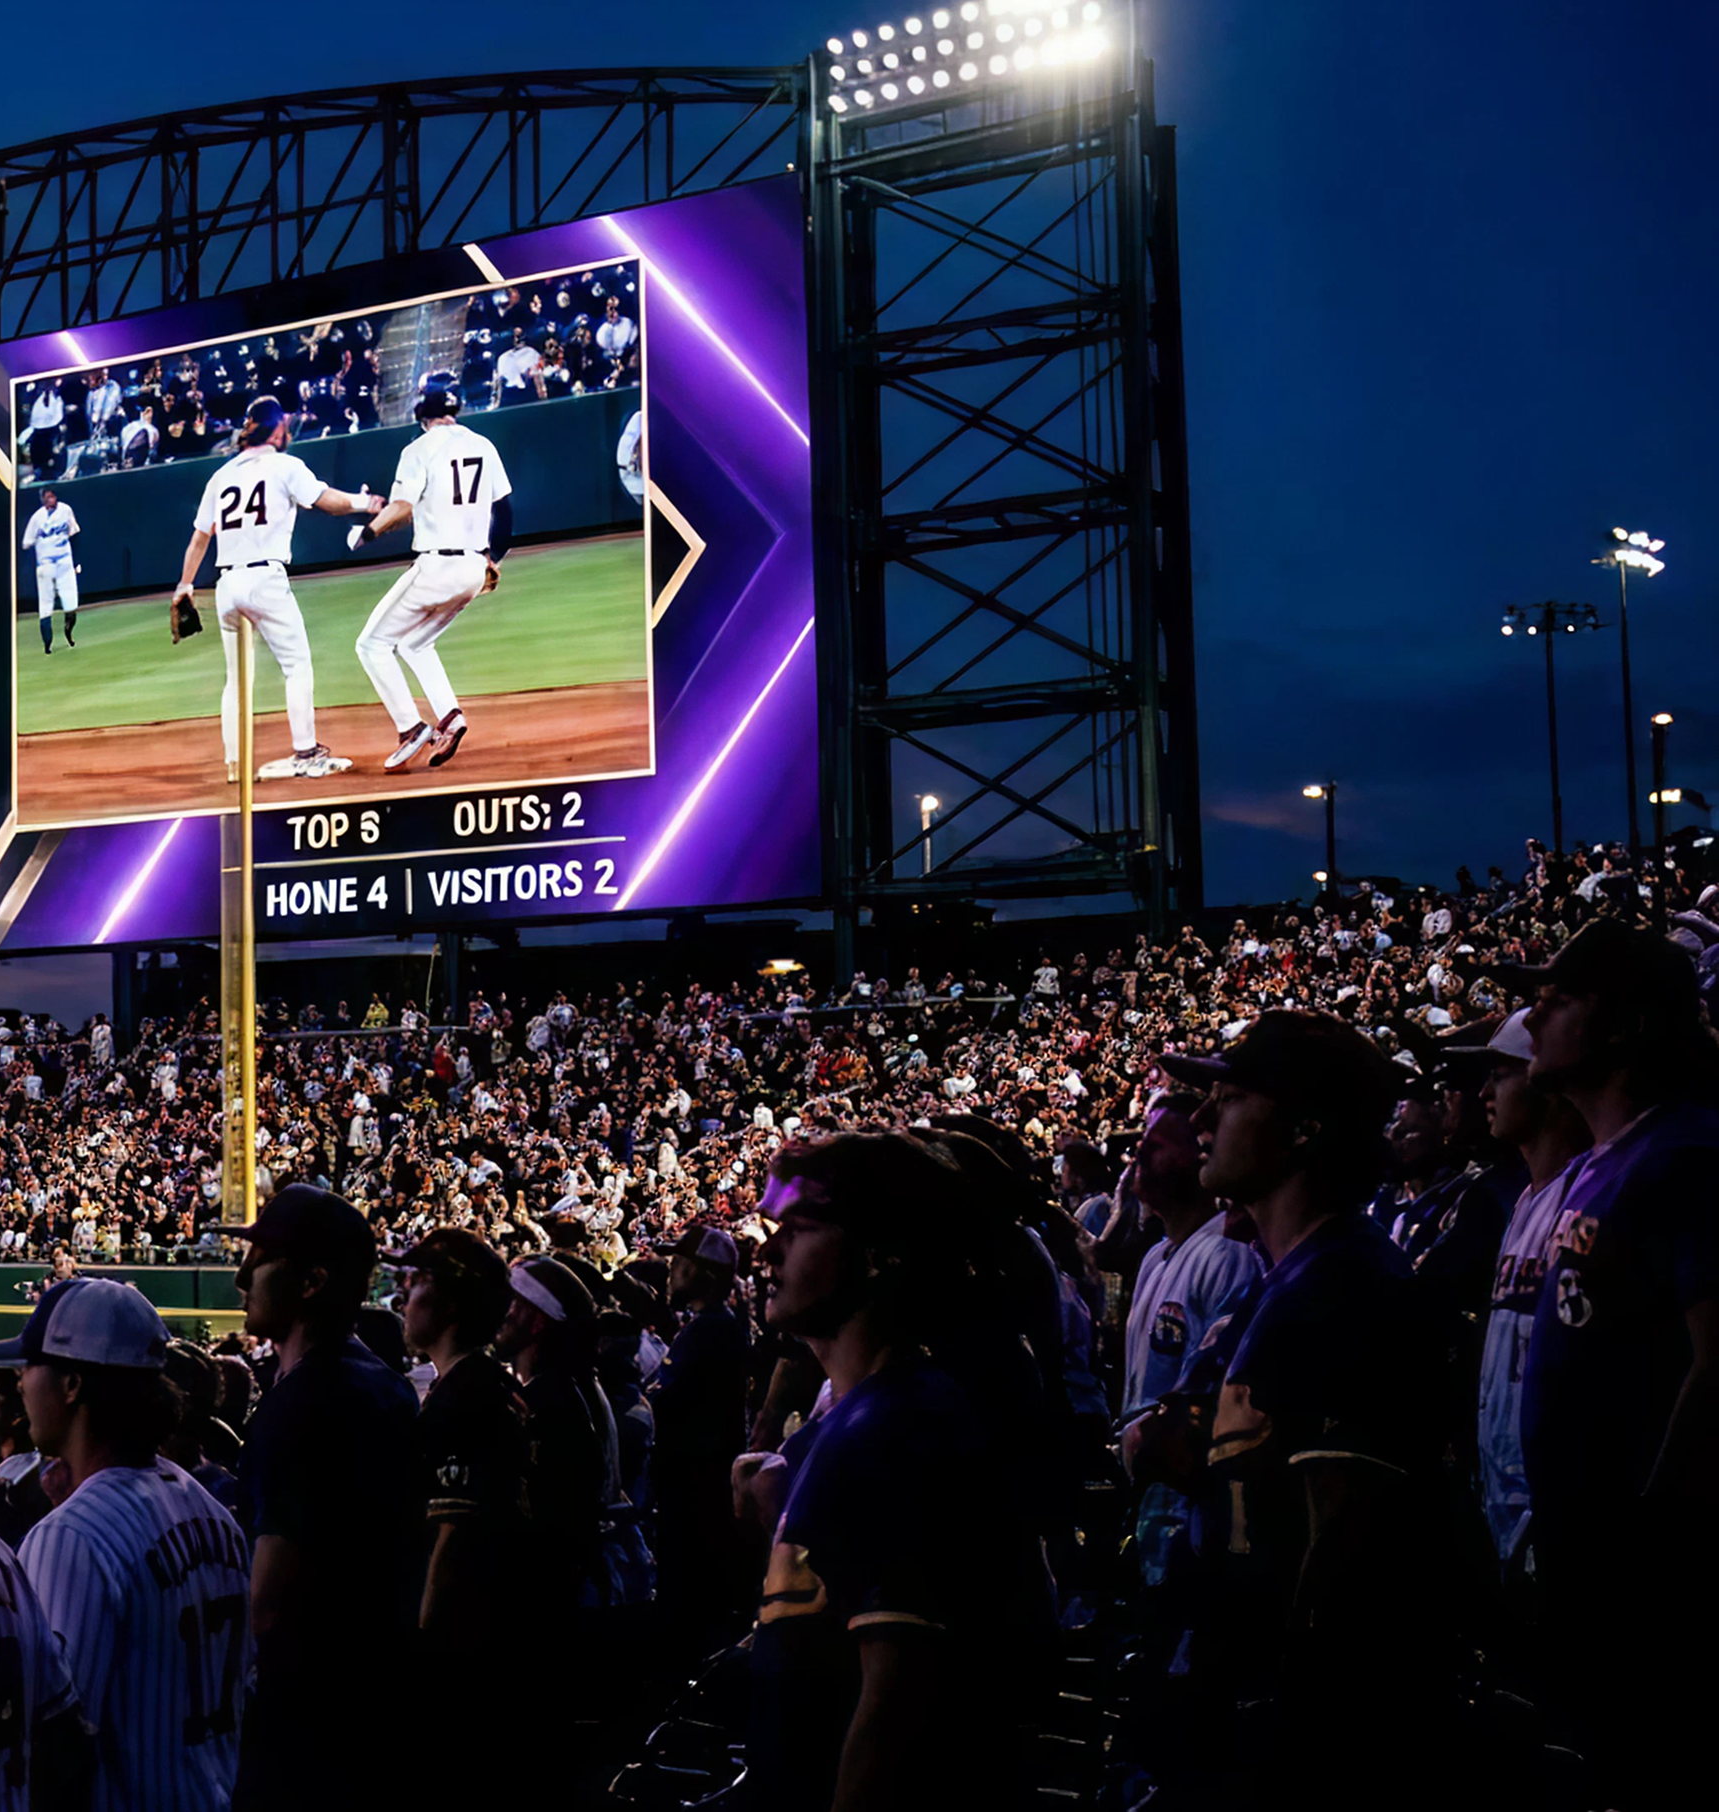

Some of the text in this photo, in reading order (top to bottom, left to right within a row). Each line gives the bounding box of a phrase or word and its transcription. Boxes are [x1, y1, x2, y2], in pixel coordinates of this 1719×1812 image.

[220, 480, 268, 531] 24
[450, 456, 484, 506] 17
[286, 812, 350, 850] TOP
[561, 791, 585, 828] 2
[366, 875, 389, 910] 4
[427, 860, 584, 907] VISITORS
[593, 858, 619, 895] 2
